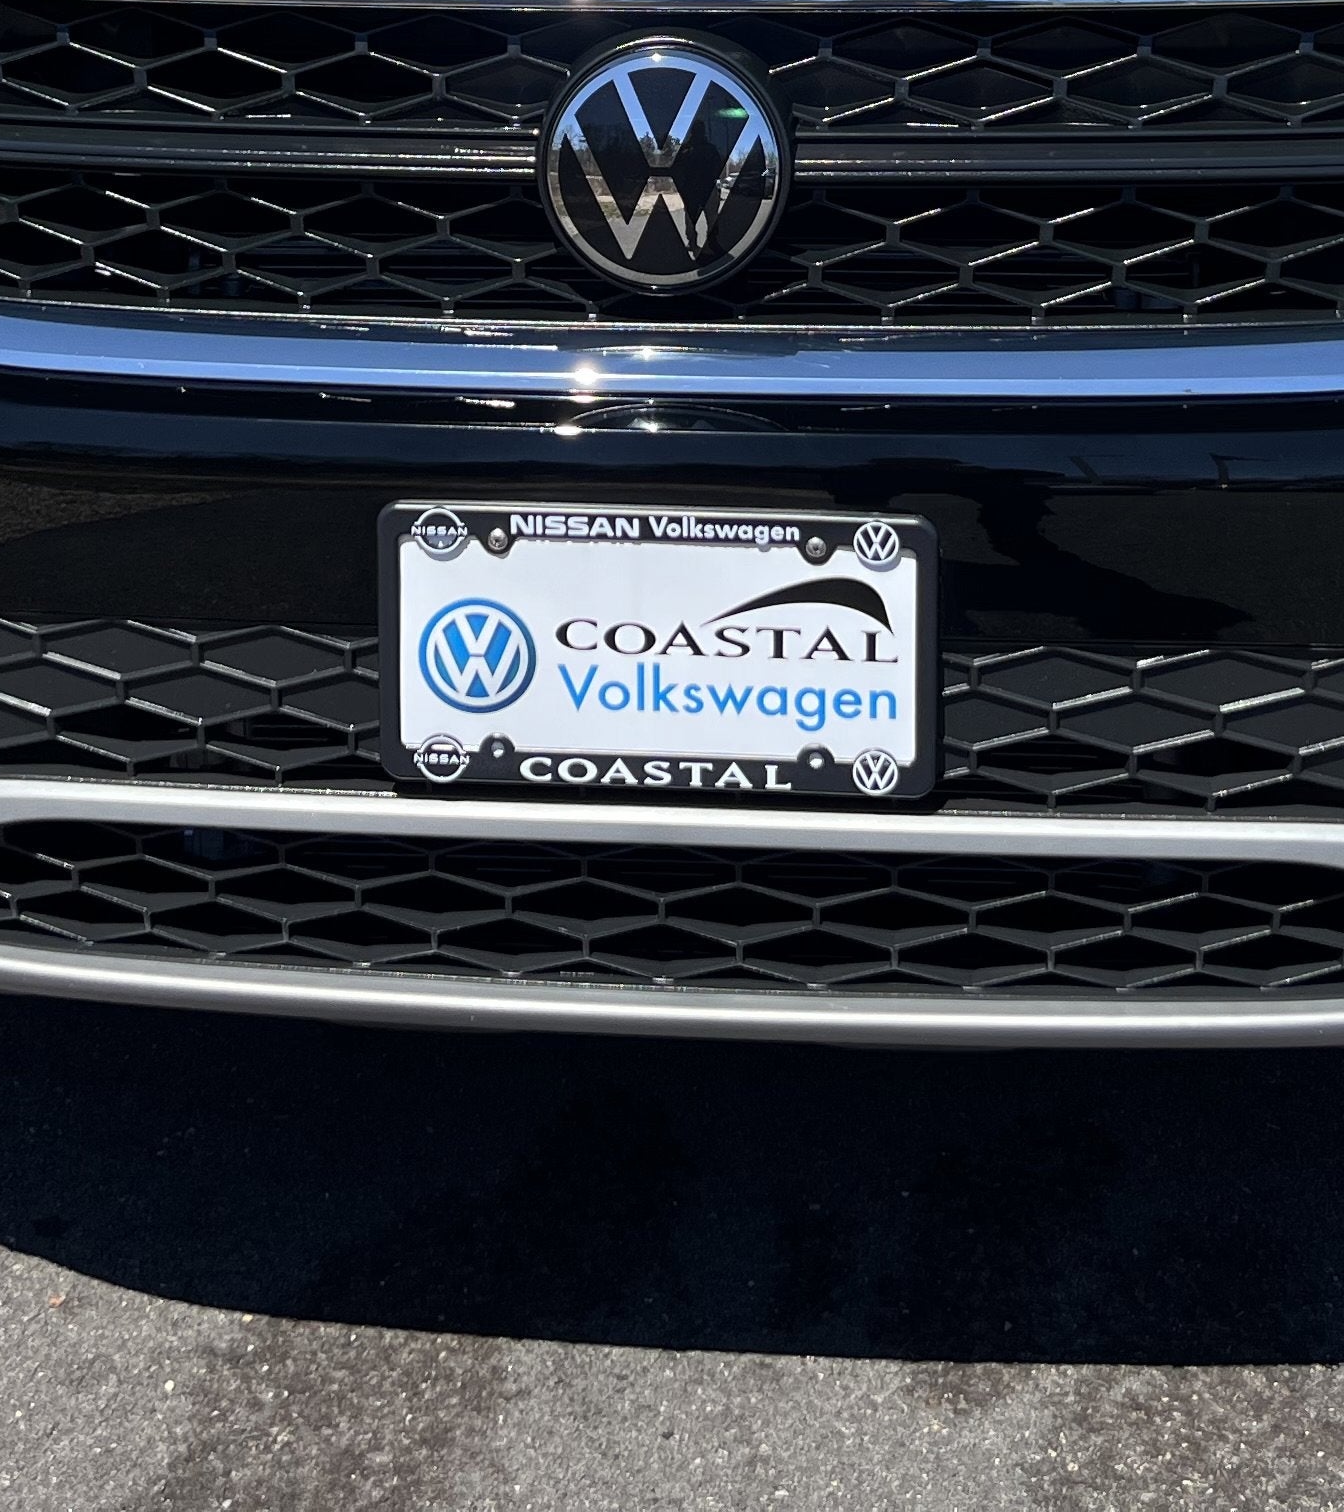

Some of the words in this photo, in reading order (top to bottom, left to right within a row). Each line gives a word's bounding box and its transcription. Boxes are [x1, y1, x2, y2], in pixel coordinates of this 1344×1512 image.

[551, 56, 773, 276] VW
[411, 525, 468, 537] NISSAN
[509, 514, 641, 538] NISSAN
[648, 516, 801, 544] Volkswagen
[854, 522, 898, 562] VW
[424, 602, 531, 707] VW
[555, 618, 899, 663] COASTAL
[558, 662, 897, 731] Volkswagen
[413, 752, 470, 766] NISSAN
[519, 756, 792, 790] COASTAL
[854, 750, 897, 792] VW
